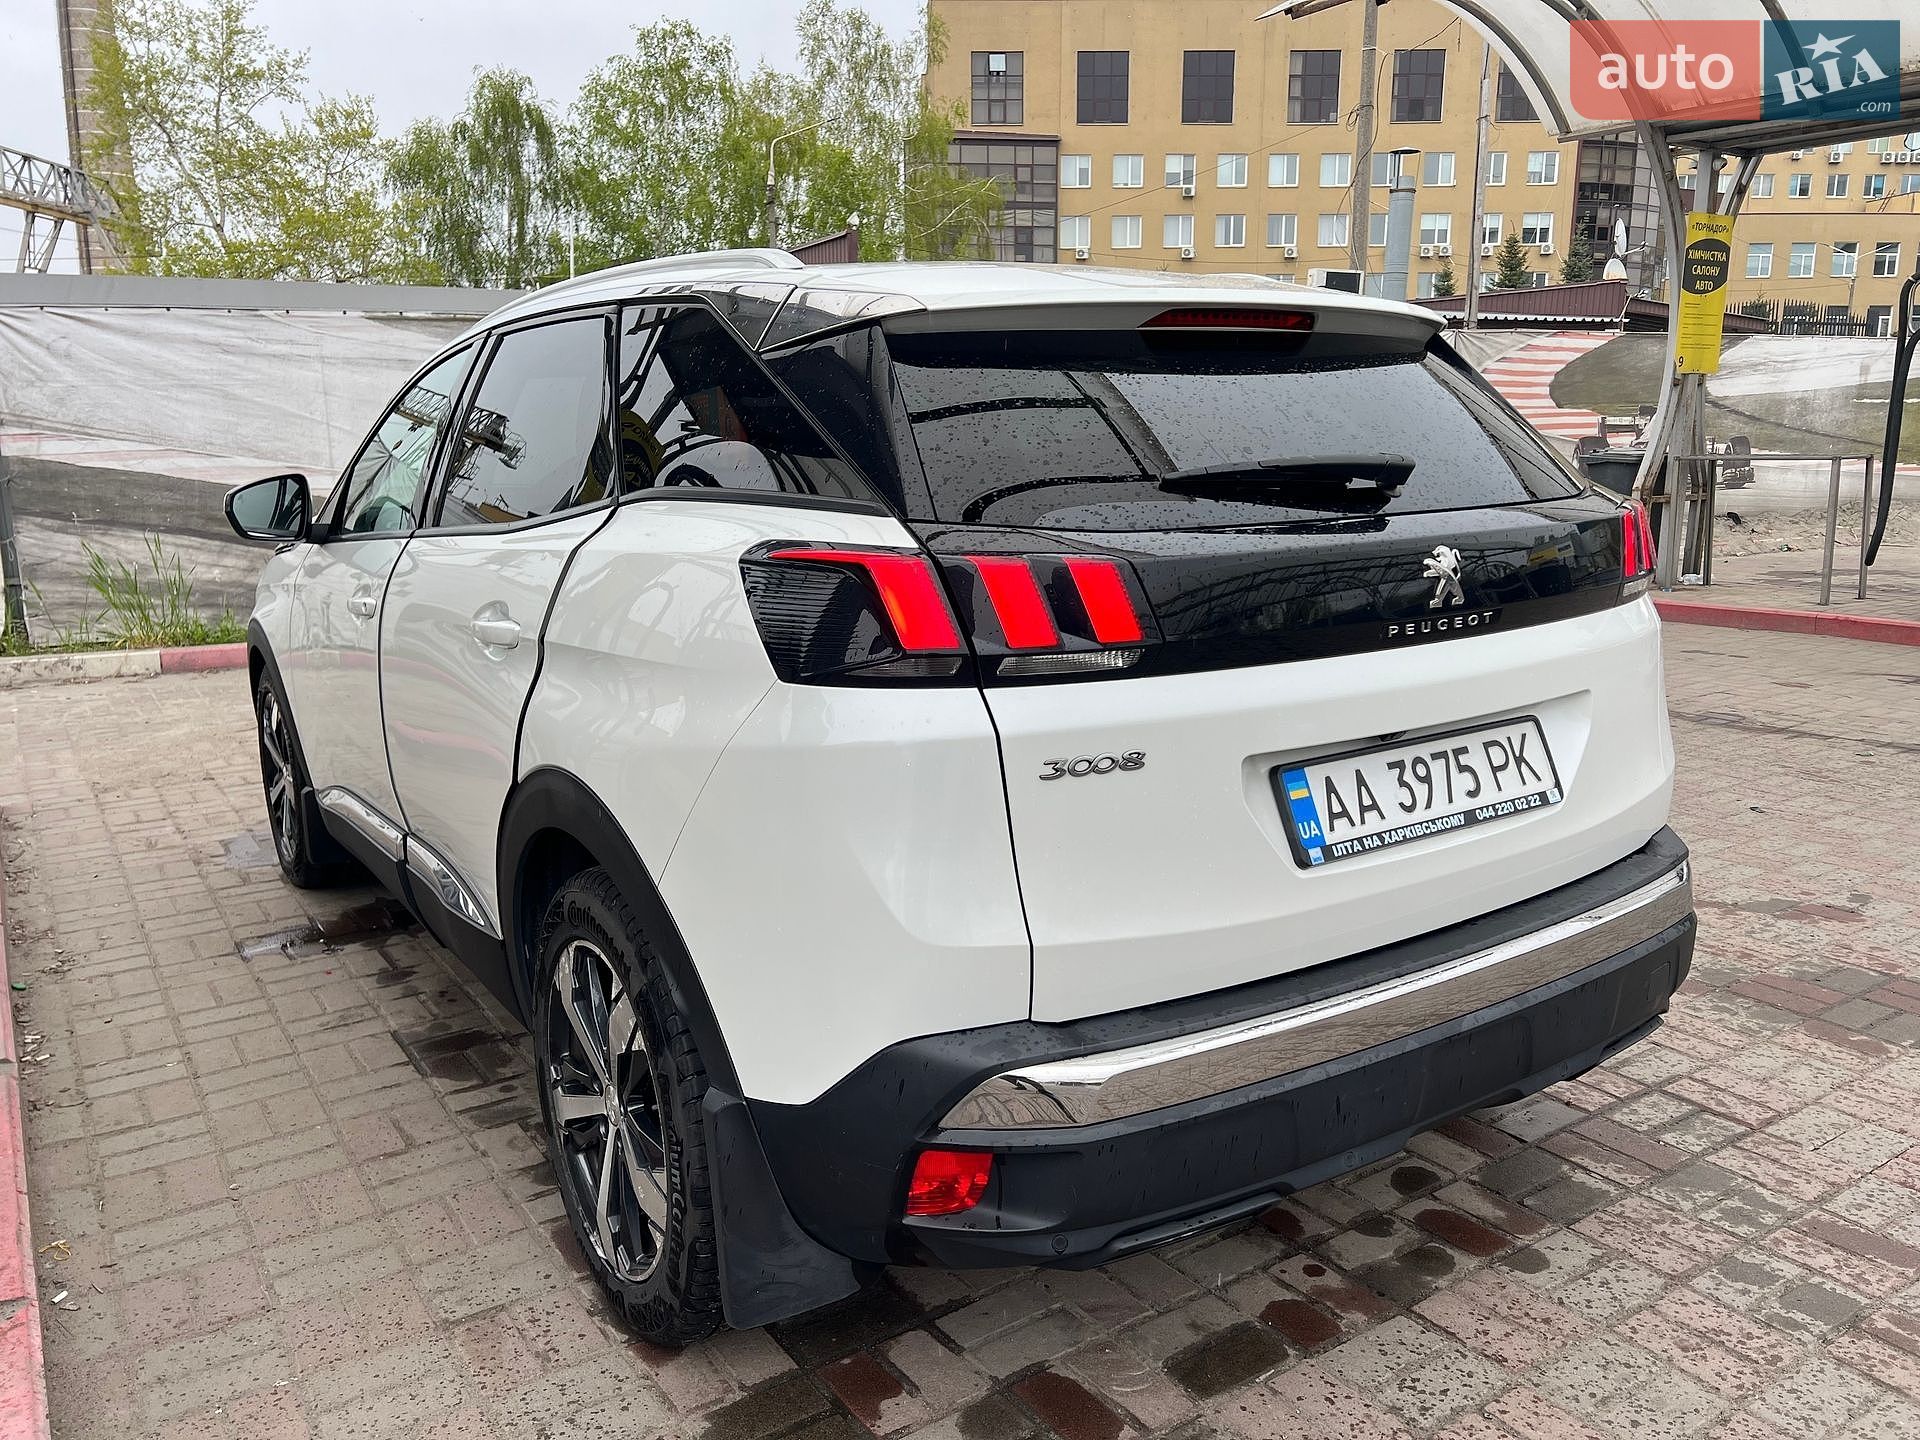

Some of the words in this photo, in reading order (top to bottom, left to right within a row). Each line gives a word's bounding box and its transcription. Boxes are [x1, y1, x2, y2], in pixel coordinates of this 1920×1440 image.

[1687, 249, 1727, 262] ХІМЧИСТКА
[1692, 264, 1720, 276] САЛОНУ
[1694, 280, 1714, 291] АВТО
[1678, 355, 1684, 367] 9
[1387, 611, 1493, 638] PEUGEOT
[1038, 749, 1147, 781] 3008
[1324, 769, 1386, 832] AA
[1386, 746, 1482, 814] 3975
[1482, 732, 1542, 792] PK
[1298, 820, 1321, 839] UA
[1363, 835, 1382, 850] НА
[1382, 813, 1465, 845] ХАРКІВСЬКОМУ
[1475, 808, 1496, 821] 044
[1497, 803, 1515, 816] 220
[1515, 799, 1529, 811] 02
[1529, 794, 1542, 807] 22
